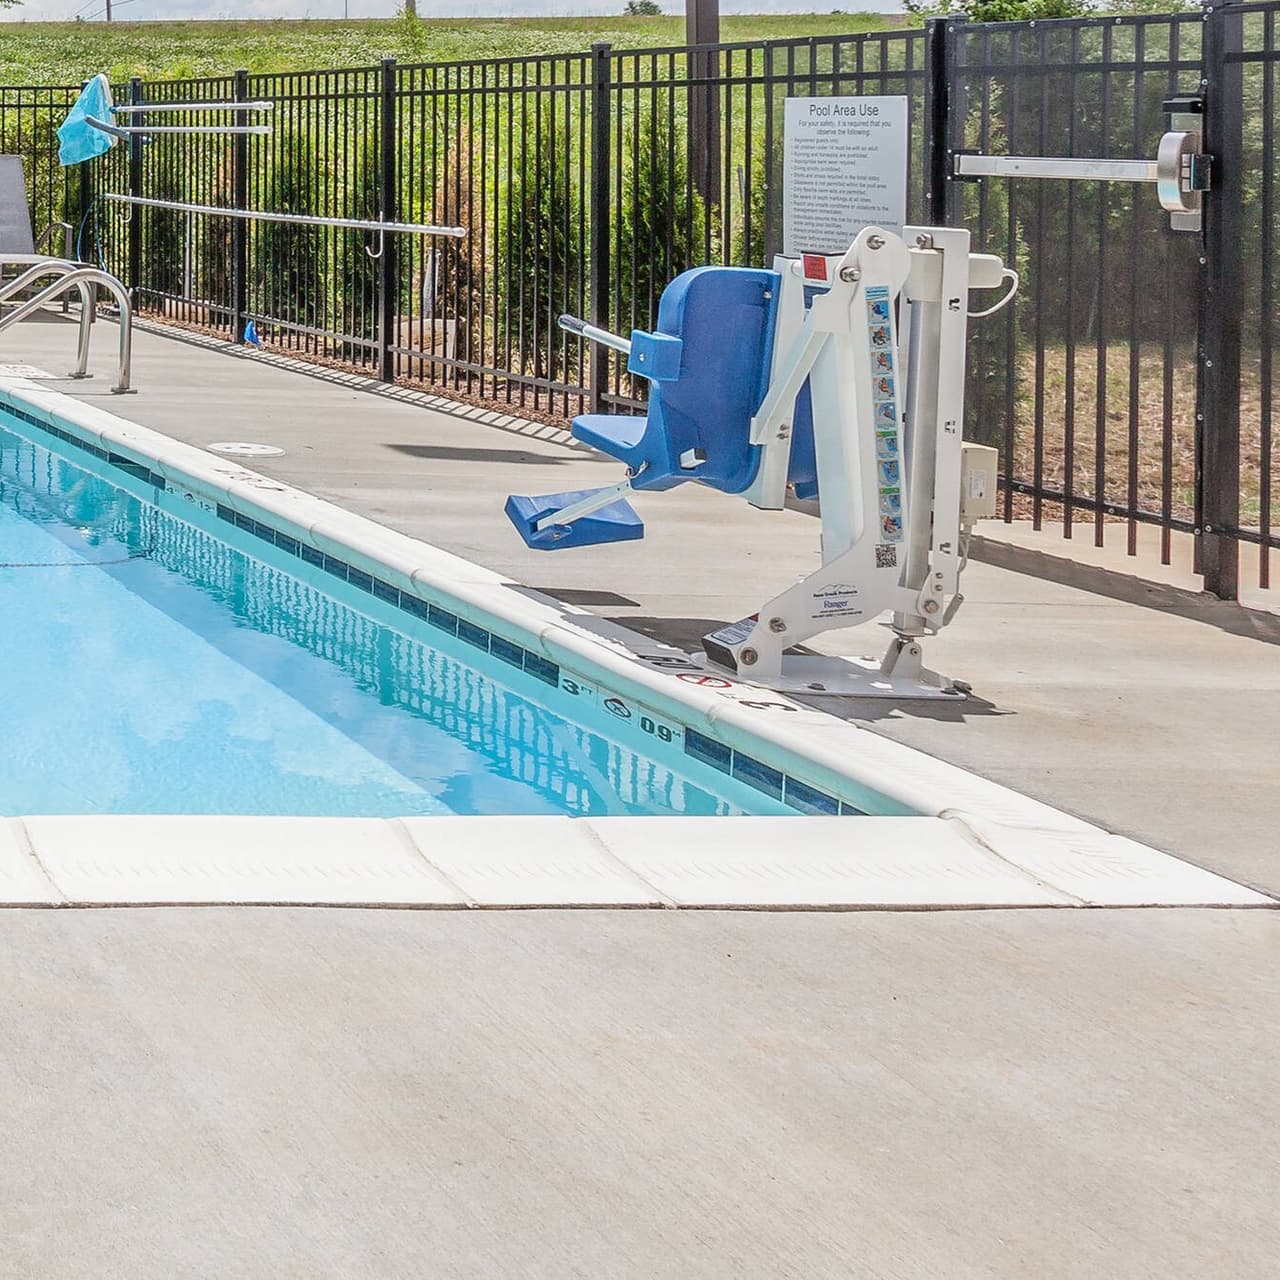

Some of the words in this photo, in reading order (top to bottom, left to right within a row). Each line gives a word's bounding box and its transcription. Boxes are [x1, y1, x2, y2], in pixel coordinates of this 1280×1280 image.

[809, 104, 831, 117] Pool
[833, 104, 856, 117] Area
[859, 104, 880, 117] Use
